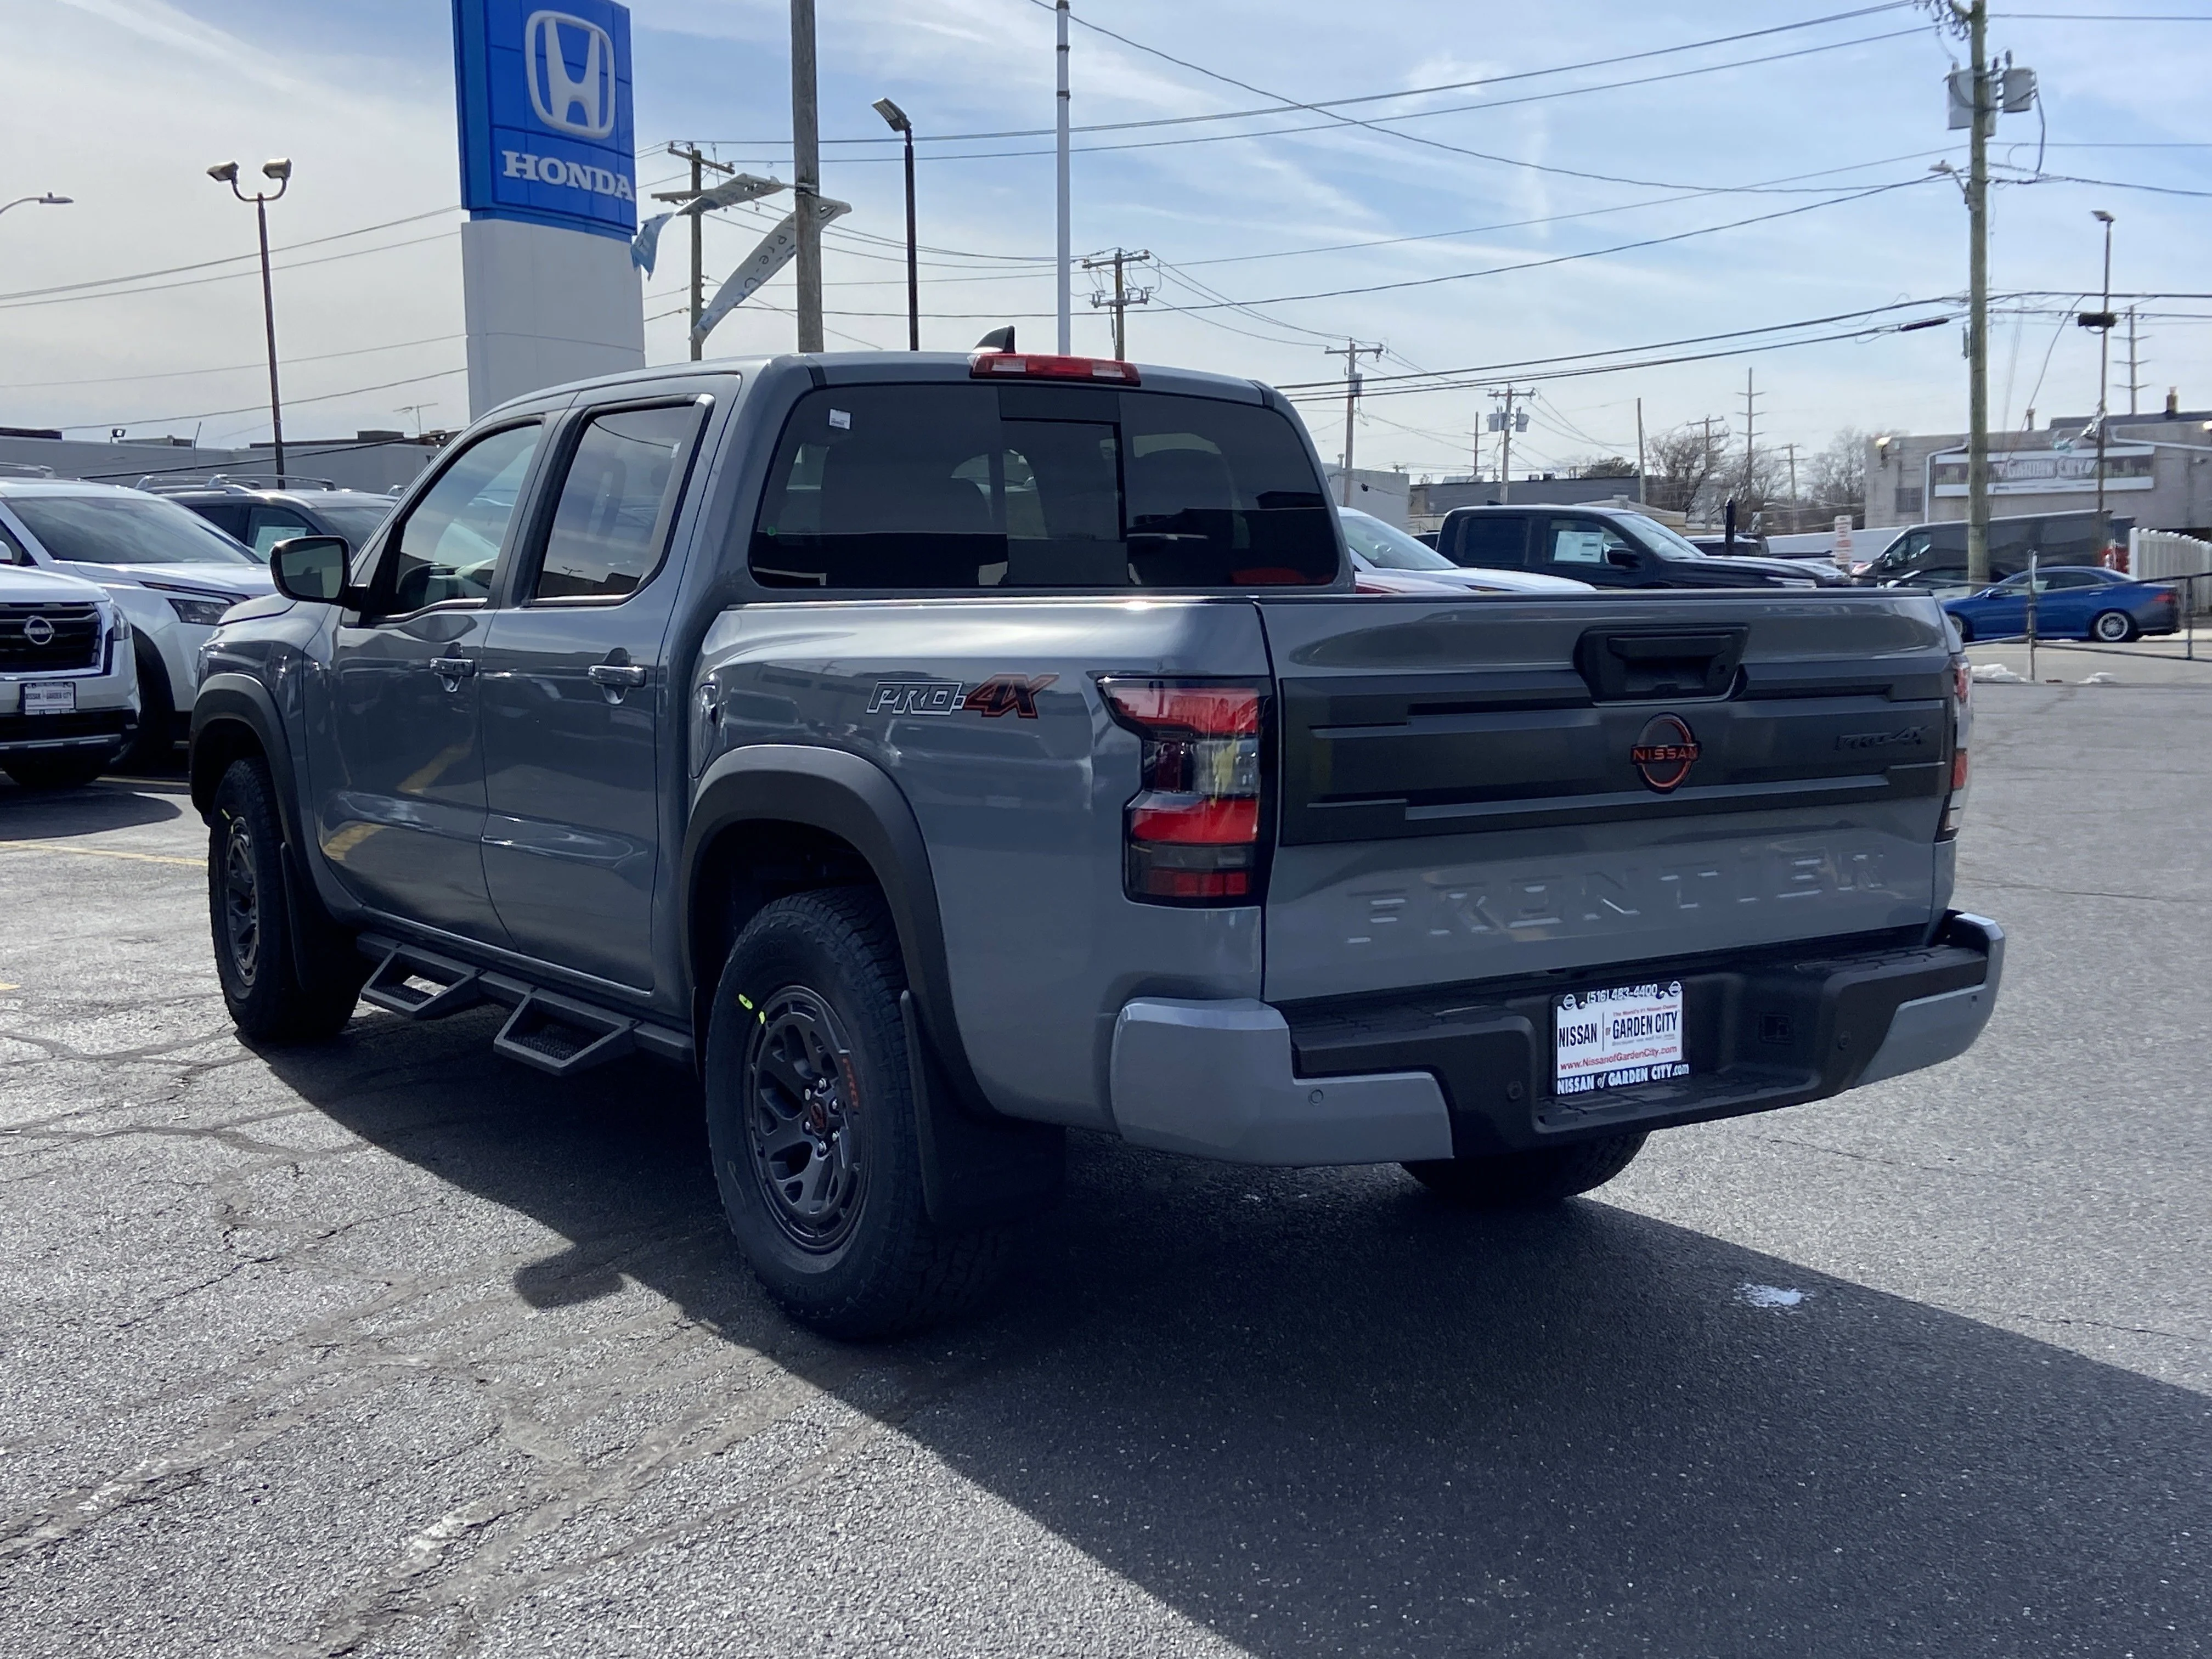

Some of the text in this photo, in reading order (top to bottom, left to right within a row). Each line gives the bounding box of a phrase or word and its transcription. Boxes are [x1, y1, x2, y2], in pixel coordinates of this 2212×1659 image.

[501, 150, 635, 201] HONDA
[1633, 747, 1699, 761] NISSAN
[1587, 990, 1609, 1004] (516)
[1559, 1023, 1597, 1048] NISSAN
[1613, 1015, 1652, 1040] GARDEN
[1655, 1010, 1678, 1032] CITY
[1560, 1046, 1677, 1070] www.NissanofGardenCity.com
[1557, 1075, 1594, 1094] NISSAN
[1597, 1073, 1606, 1088] of
[1608, 1067, 1649, 1087] GARDEN
